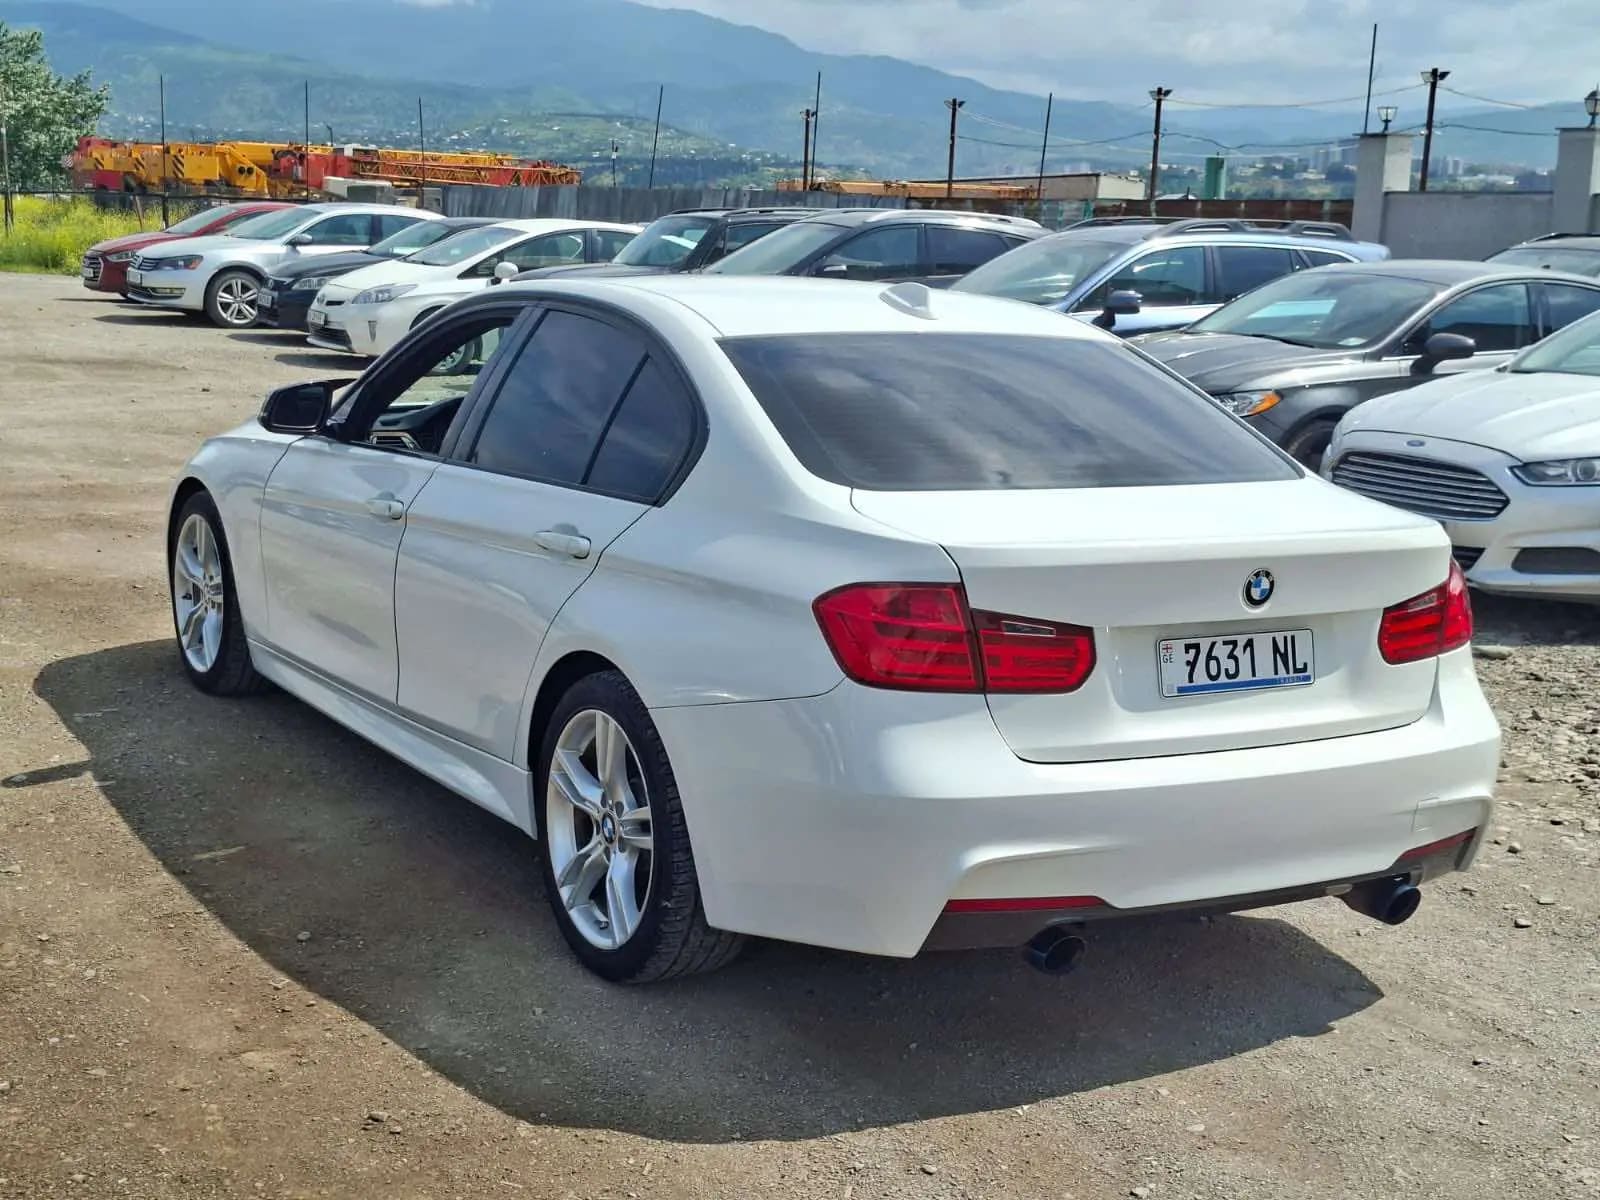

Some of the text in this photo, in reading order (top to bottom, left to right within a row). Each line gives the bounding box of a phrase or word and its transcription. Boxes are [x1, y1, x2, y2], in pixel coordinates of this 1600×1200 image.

[1162, 654, 1174, 664] GE
[1184, 634, 1308, 683] 7631 NL
